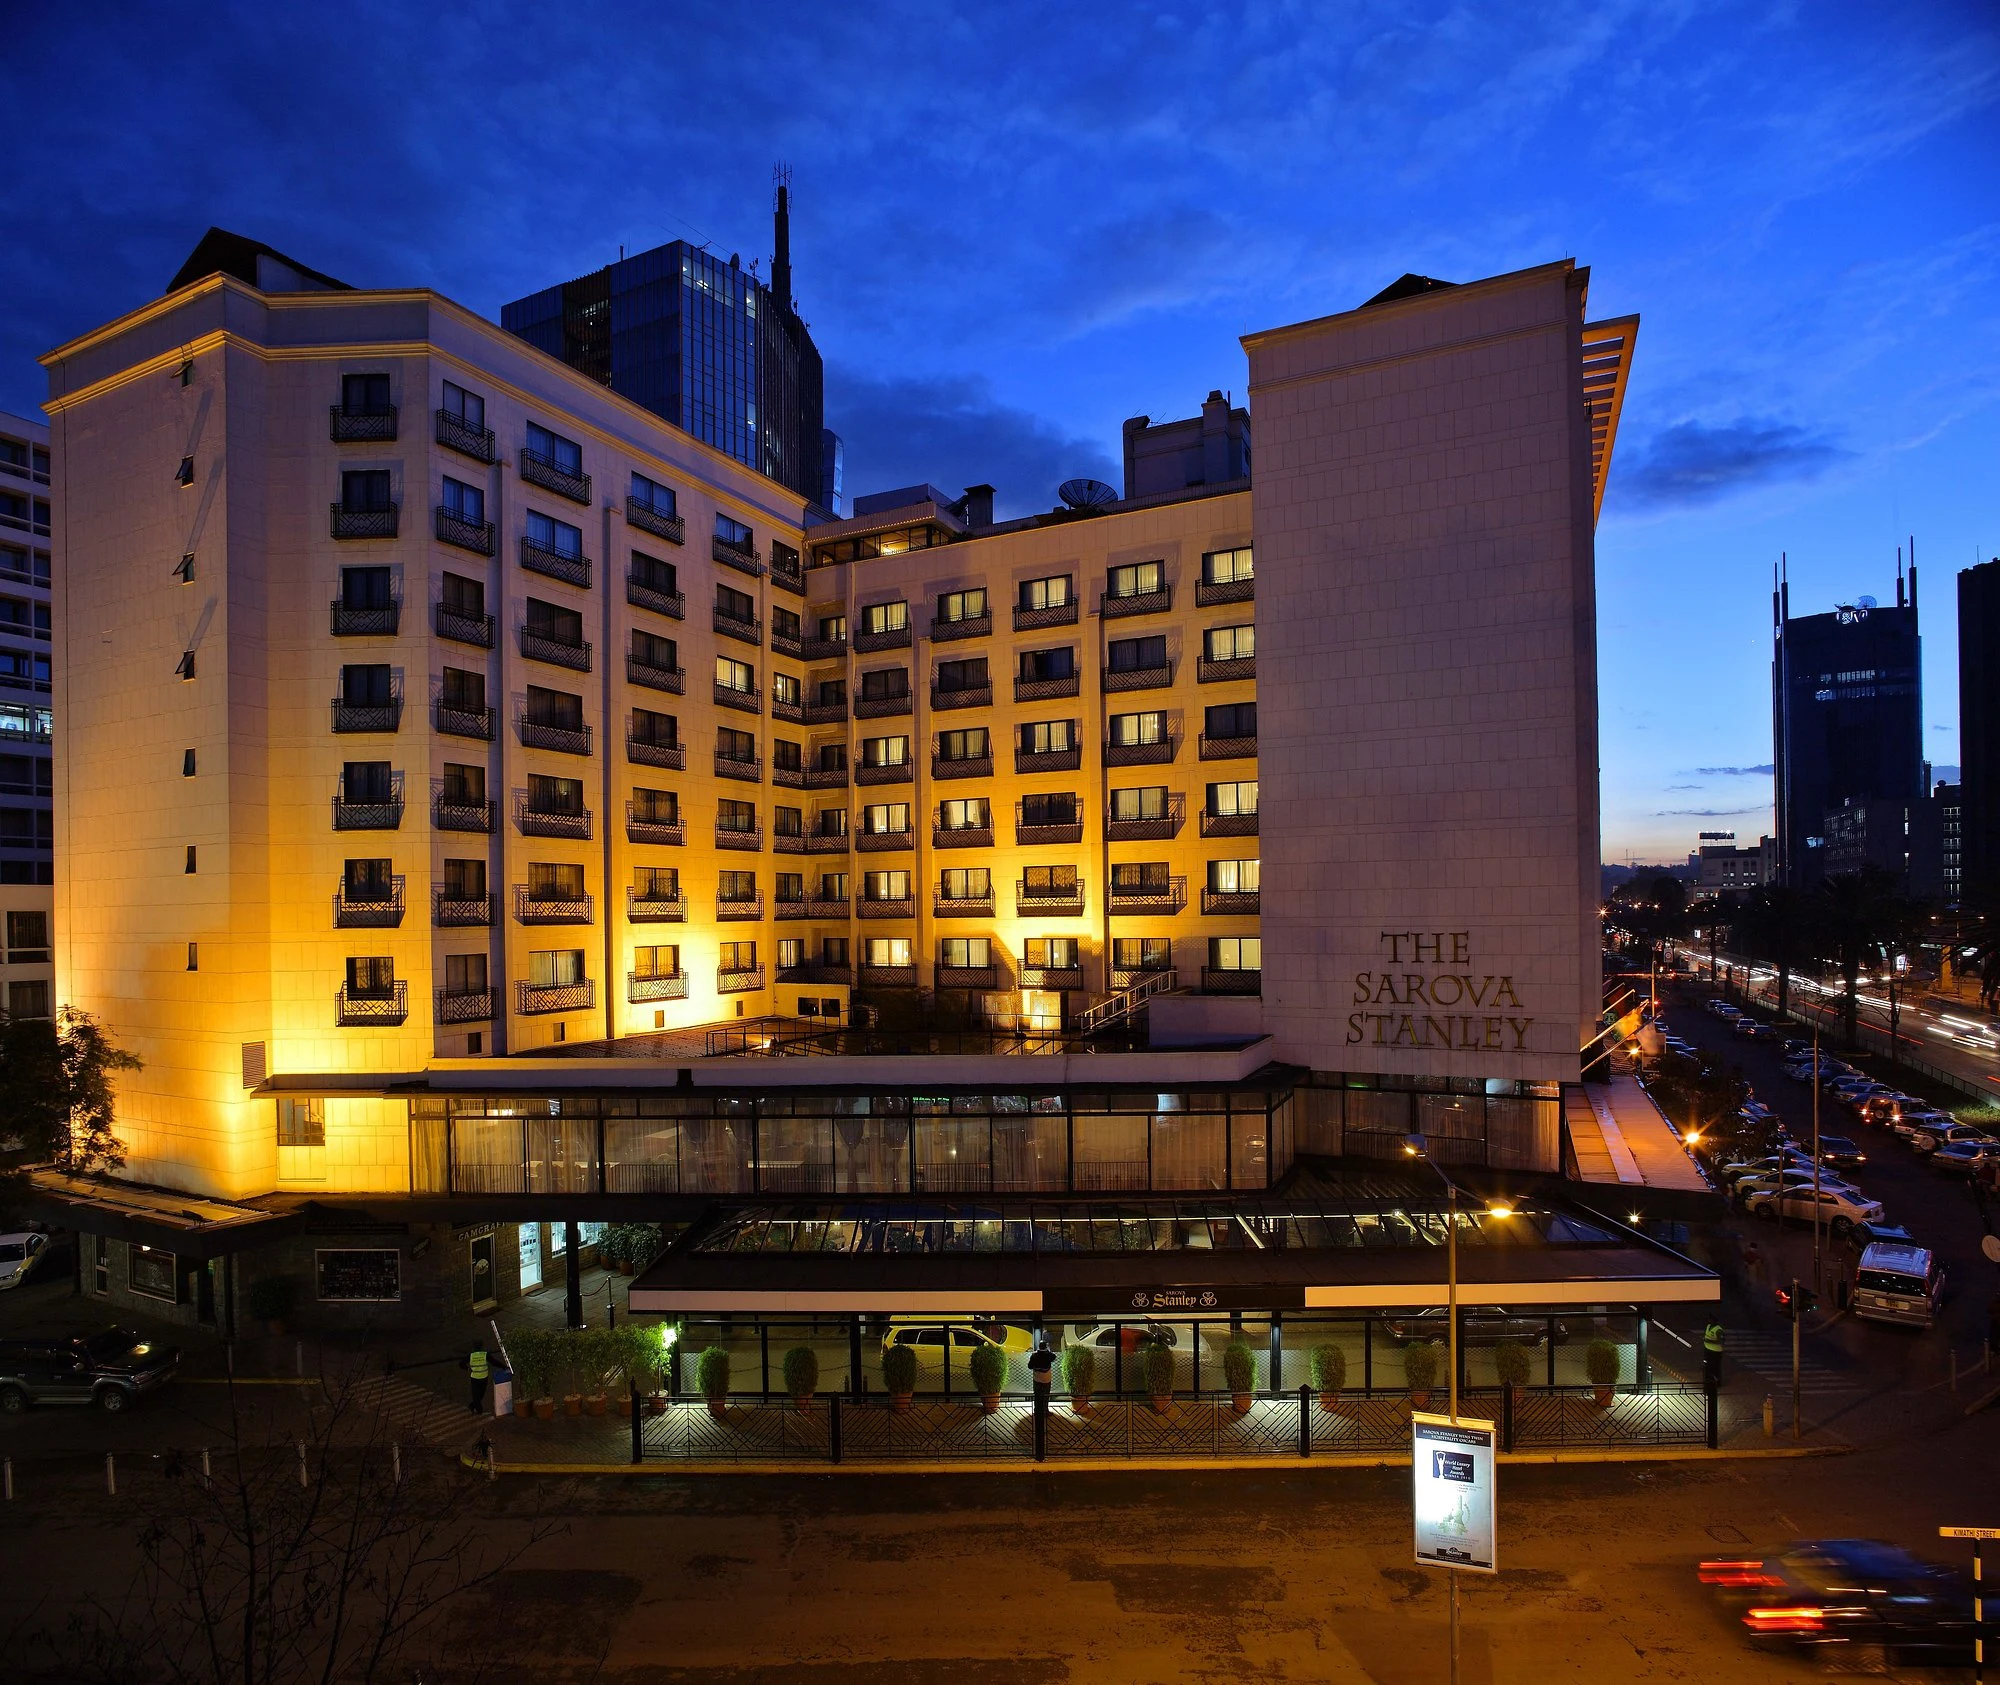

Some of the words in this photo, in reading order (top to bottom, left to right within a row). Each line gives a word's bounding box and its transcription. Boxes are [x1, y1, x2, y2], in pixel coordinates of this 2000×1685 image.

[1381, 930, 1470, 966] THE
[1353, 971, 1524, 1008] SAROVA
[1346, 1011, 1535, 1051] STANLEY
[1152, 1294, 1196, 1308] Stanley
[1953, 1529, 1975, 1537] KIMATHI
[1976, 1530, 1996, 1538] STREET
